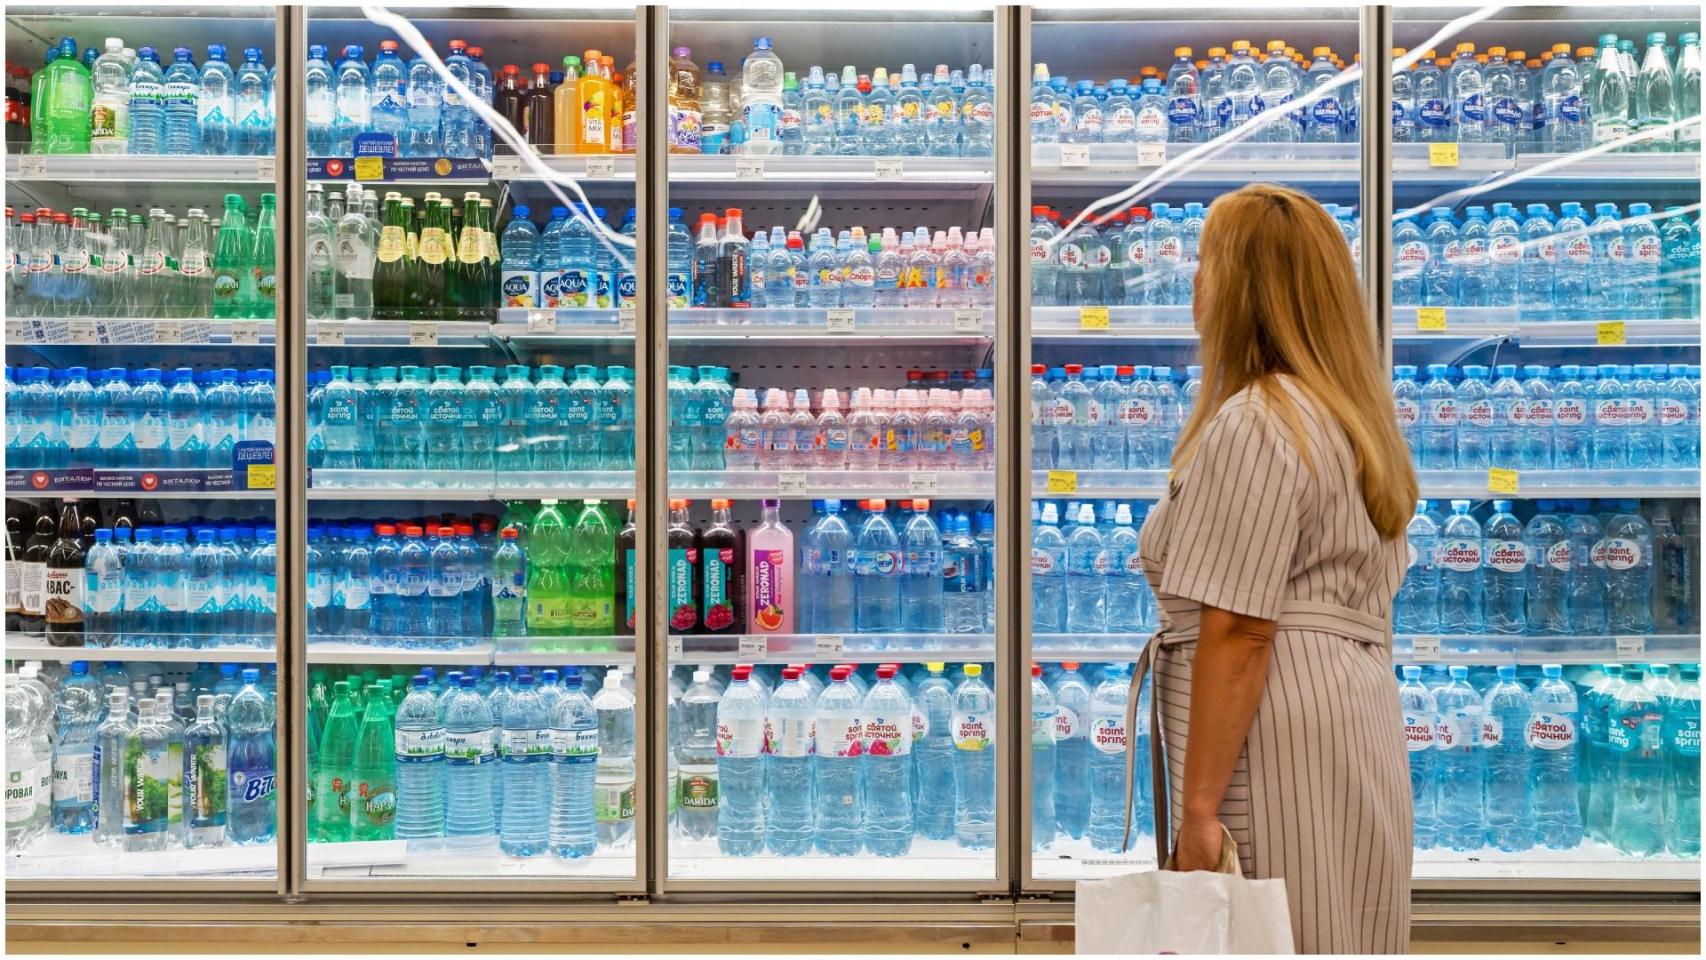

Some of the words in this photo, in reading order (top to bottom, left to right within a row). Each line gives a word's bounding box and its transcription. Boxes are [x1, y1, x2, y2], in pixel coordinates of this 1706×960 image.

[505, 283, 527, 291] AQUA
[560, 279, 586, 288] AQUA
[1448, 548, 1478, 556] святой
[677, 560, 687, 604] ZERONAD
[710, 560, 720, 604] ZERONAD
[760, 561, 770, 606] ZERONAD
[866, 723, 897, 732] святой
[961, 722, 984, 730] saint
[959, 730, 986, 739] spring
[1099, 727, 1125, 735] saint
[1096, 735, 1127, 746] spring
[685, 797, 716, 806] DARIDA
